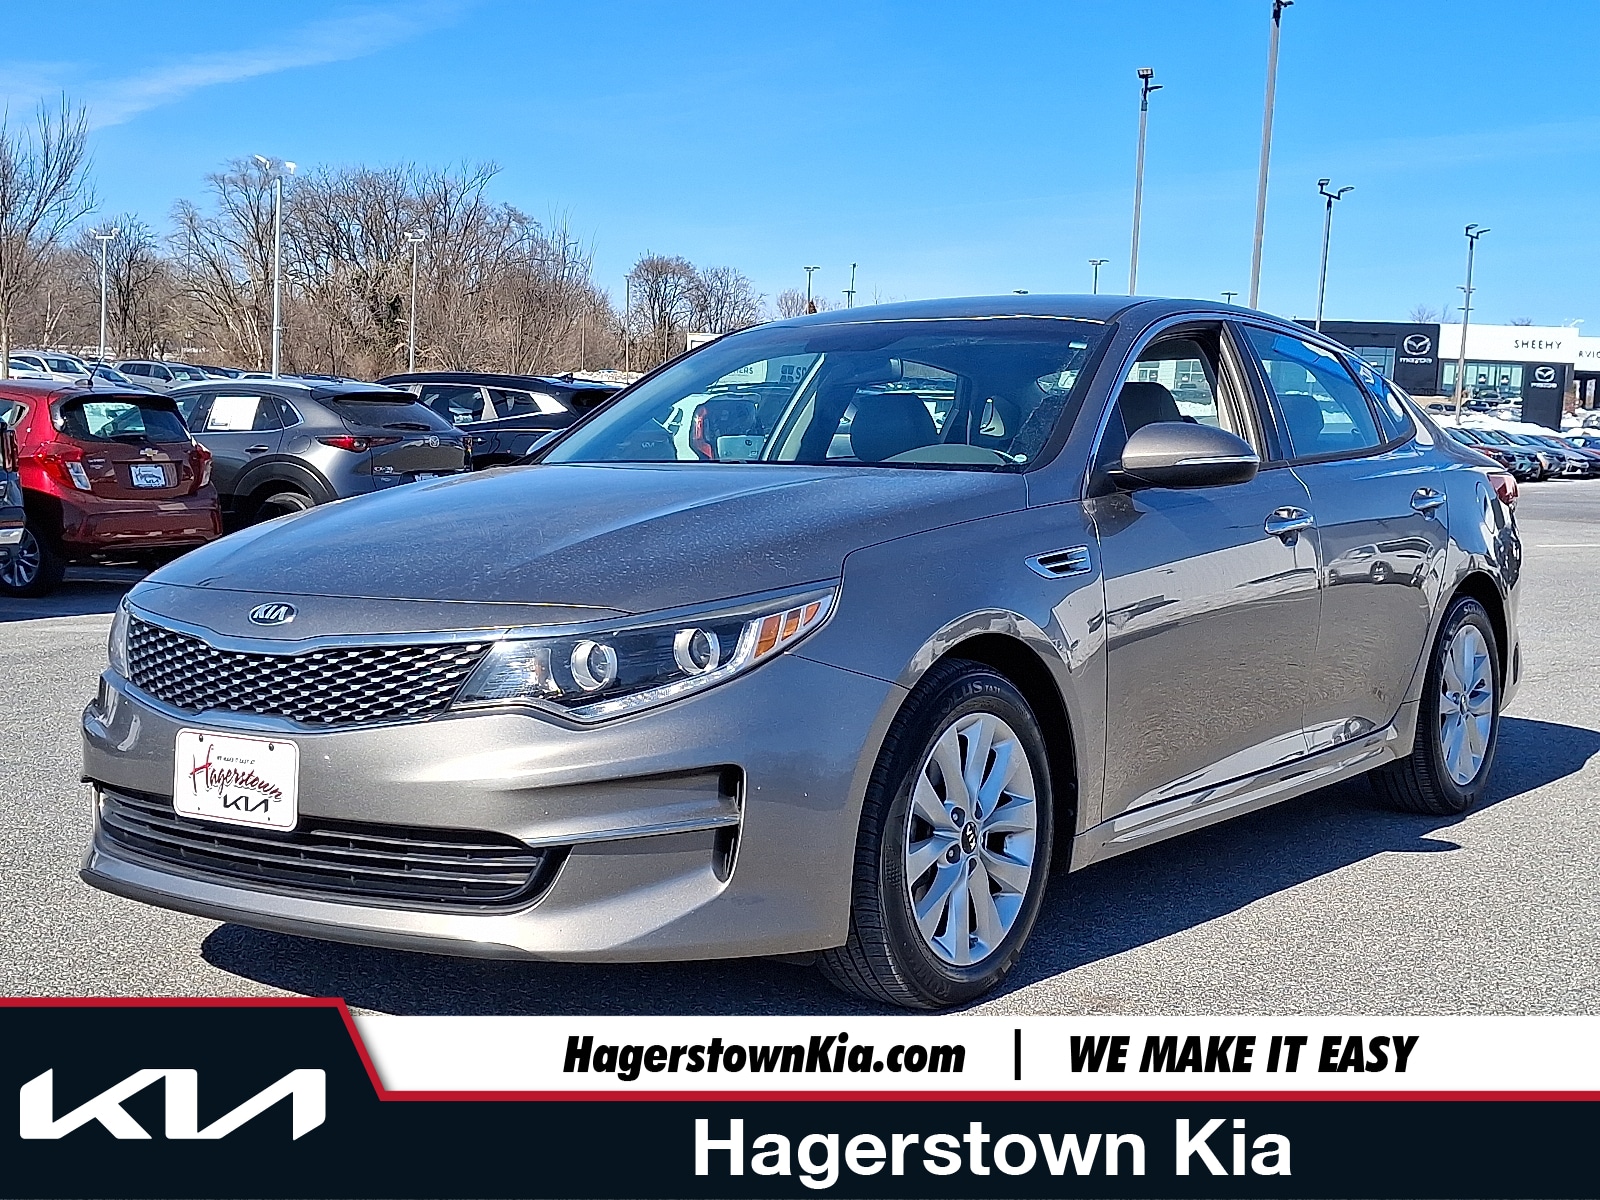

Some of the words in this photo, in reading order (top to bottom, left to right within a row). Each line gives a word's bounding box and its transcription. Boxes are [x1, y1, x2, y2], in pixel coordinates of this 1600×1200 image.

[1513, 339, 1562, 350] SHEEHY
[1399, 357, 1433, 365] mazda
[253, 604, 289, 621] KIA
[189, 744, 283, 801] Hagerstown
[223, 794, 269, 813] KIA
